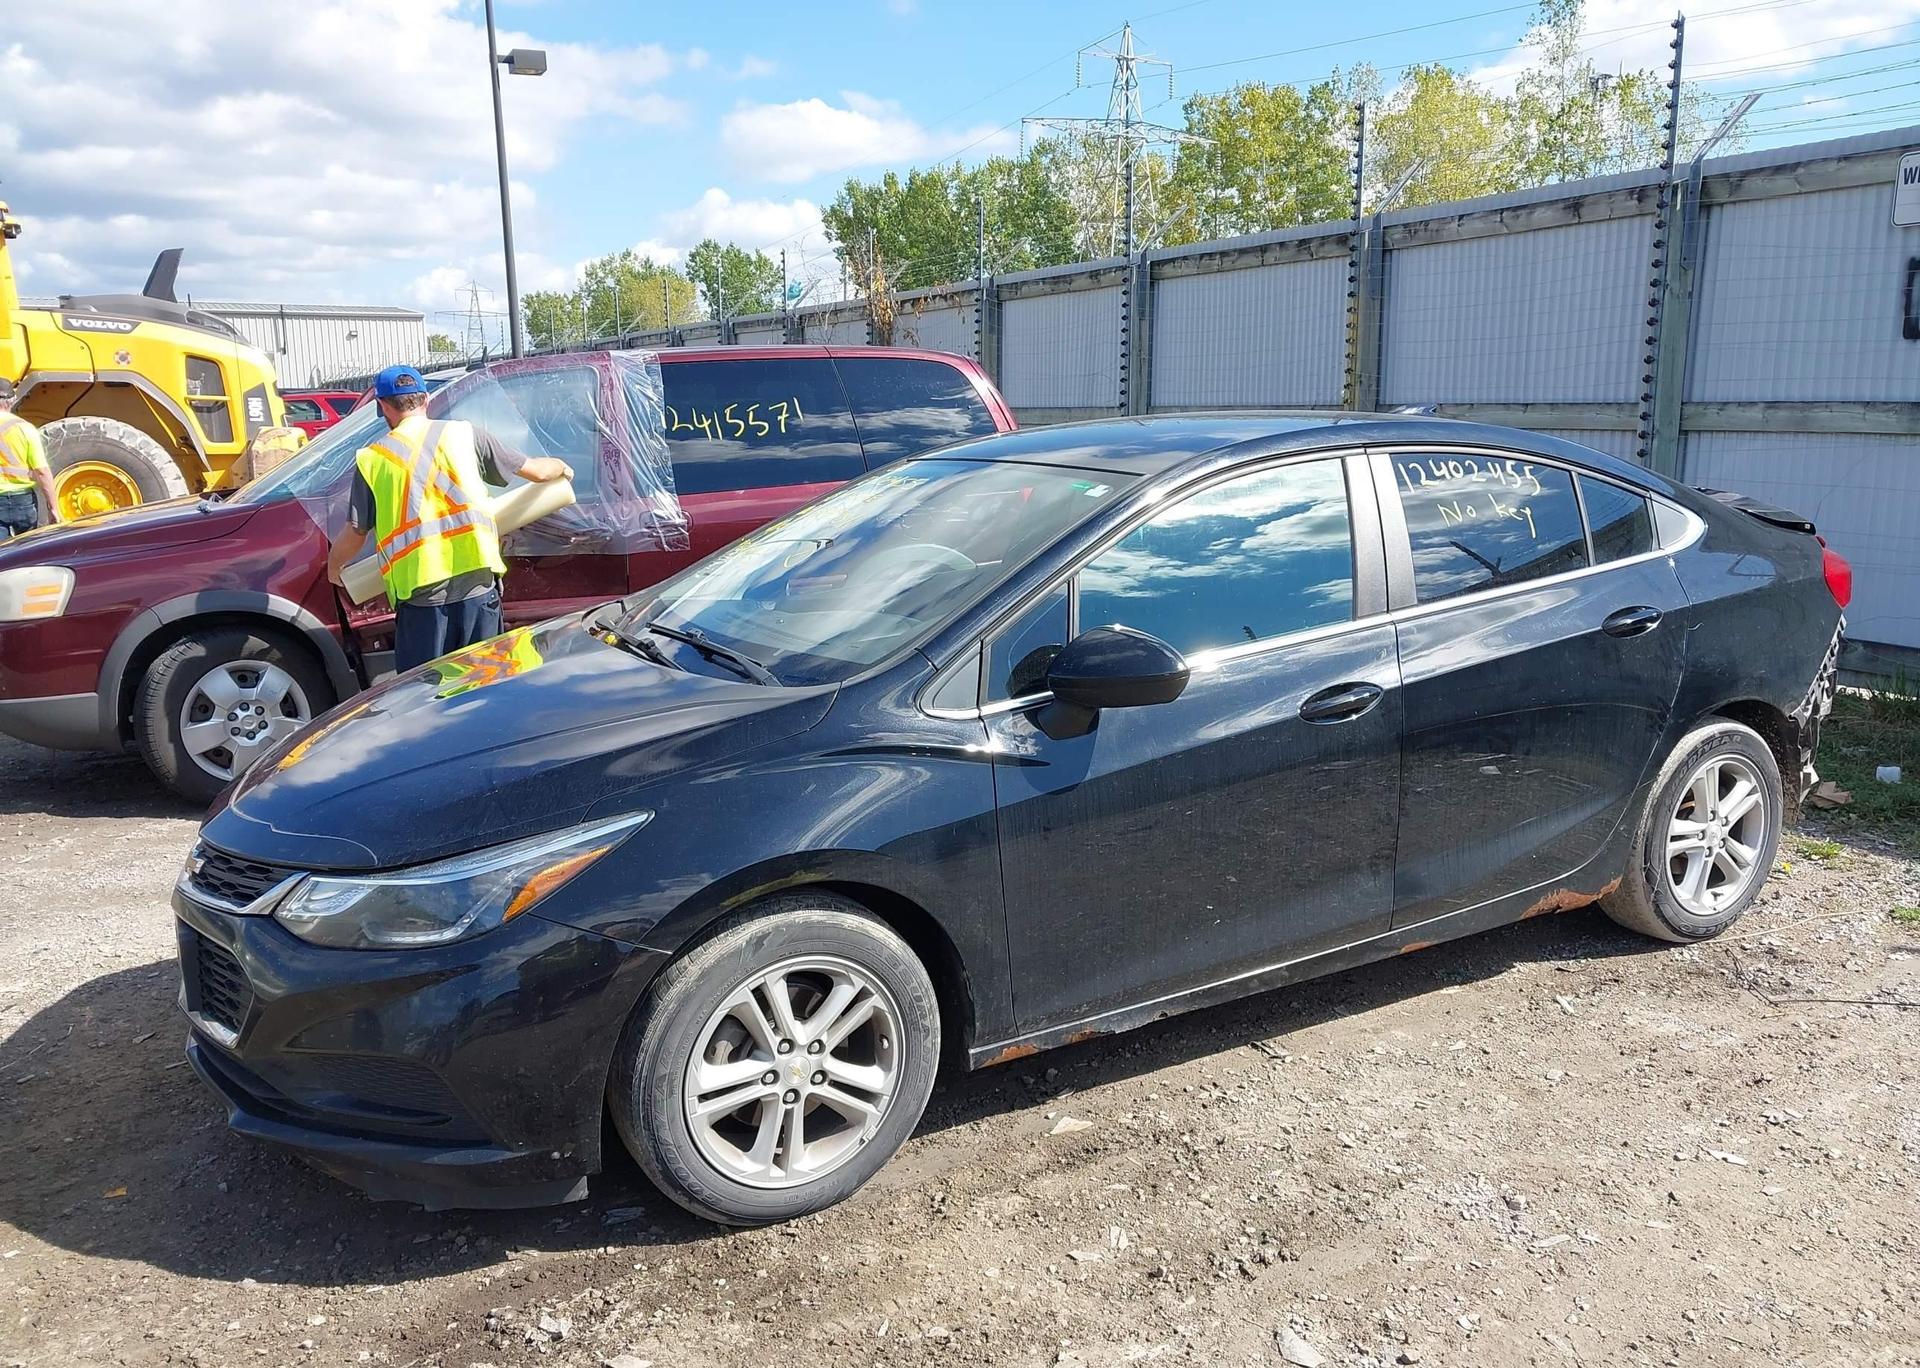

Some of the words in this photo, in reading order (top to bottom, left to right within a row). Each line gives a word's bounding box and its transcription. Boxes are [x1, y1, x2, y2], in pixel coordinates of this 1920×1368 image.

[1903, 166, 1920, 185] W
[67, 318, 132, 331] VOLVO
[247, 397, 265, 422] L90H
[1398, 458, 1541, 496] 12402455
[1437, 500, 1476, 527] No
